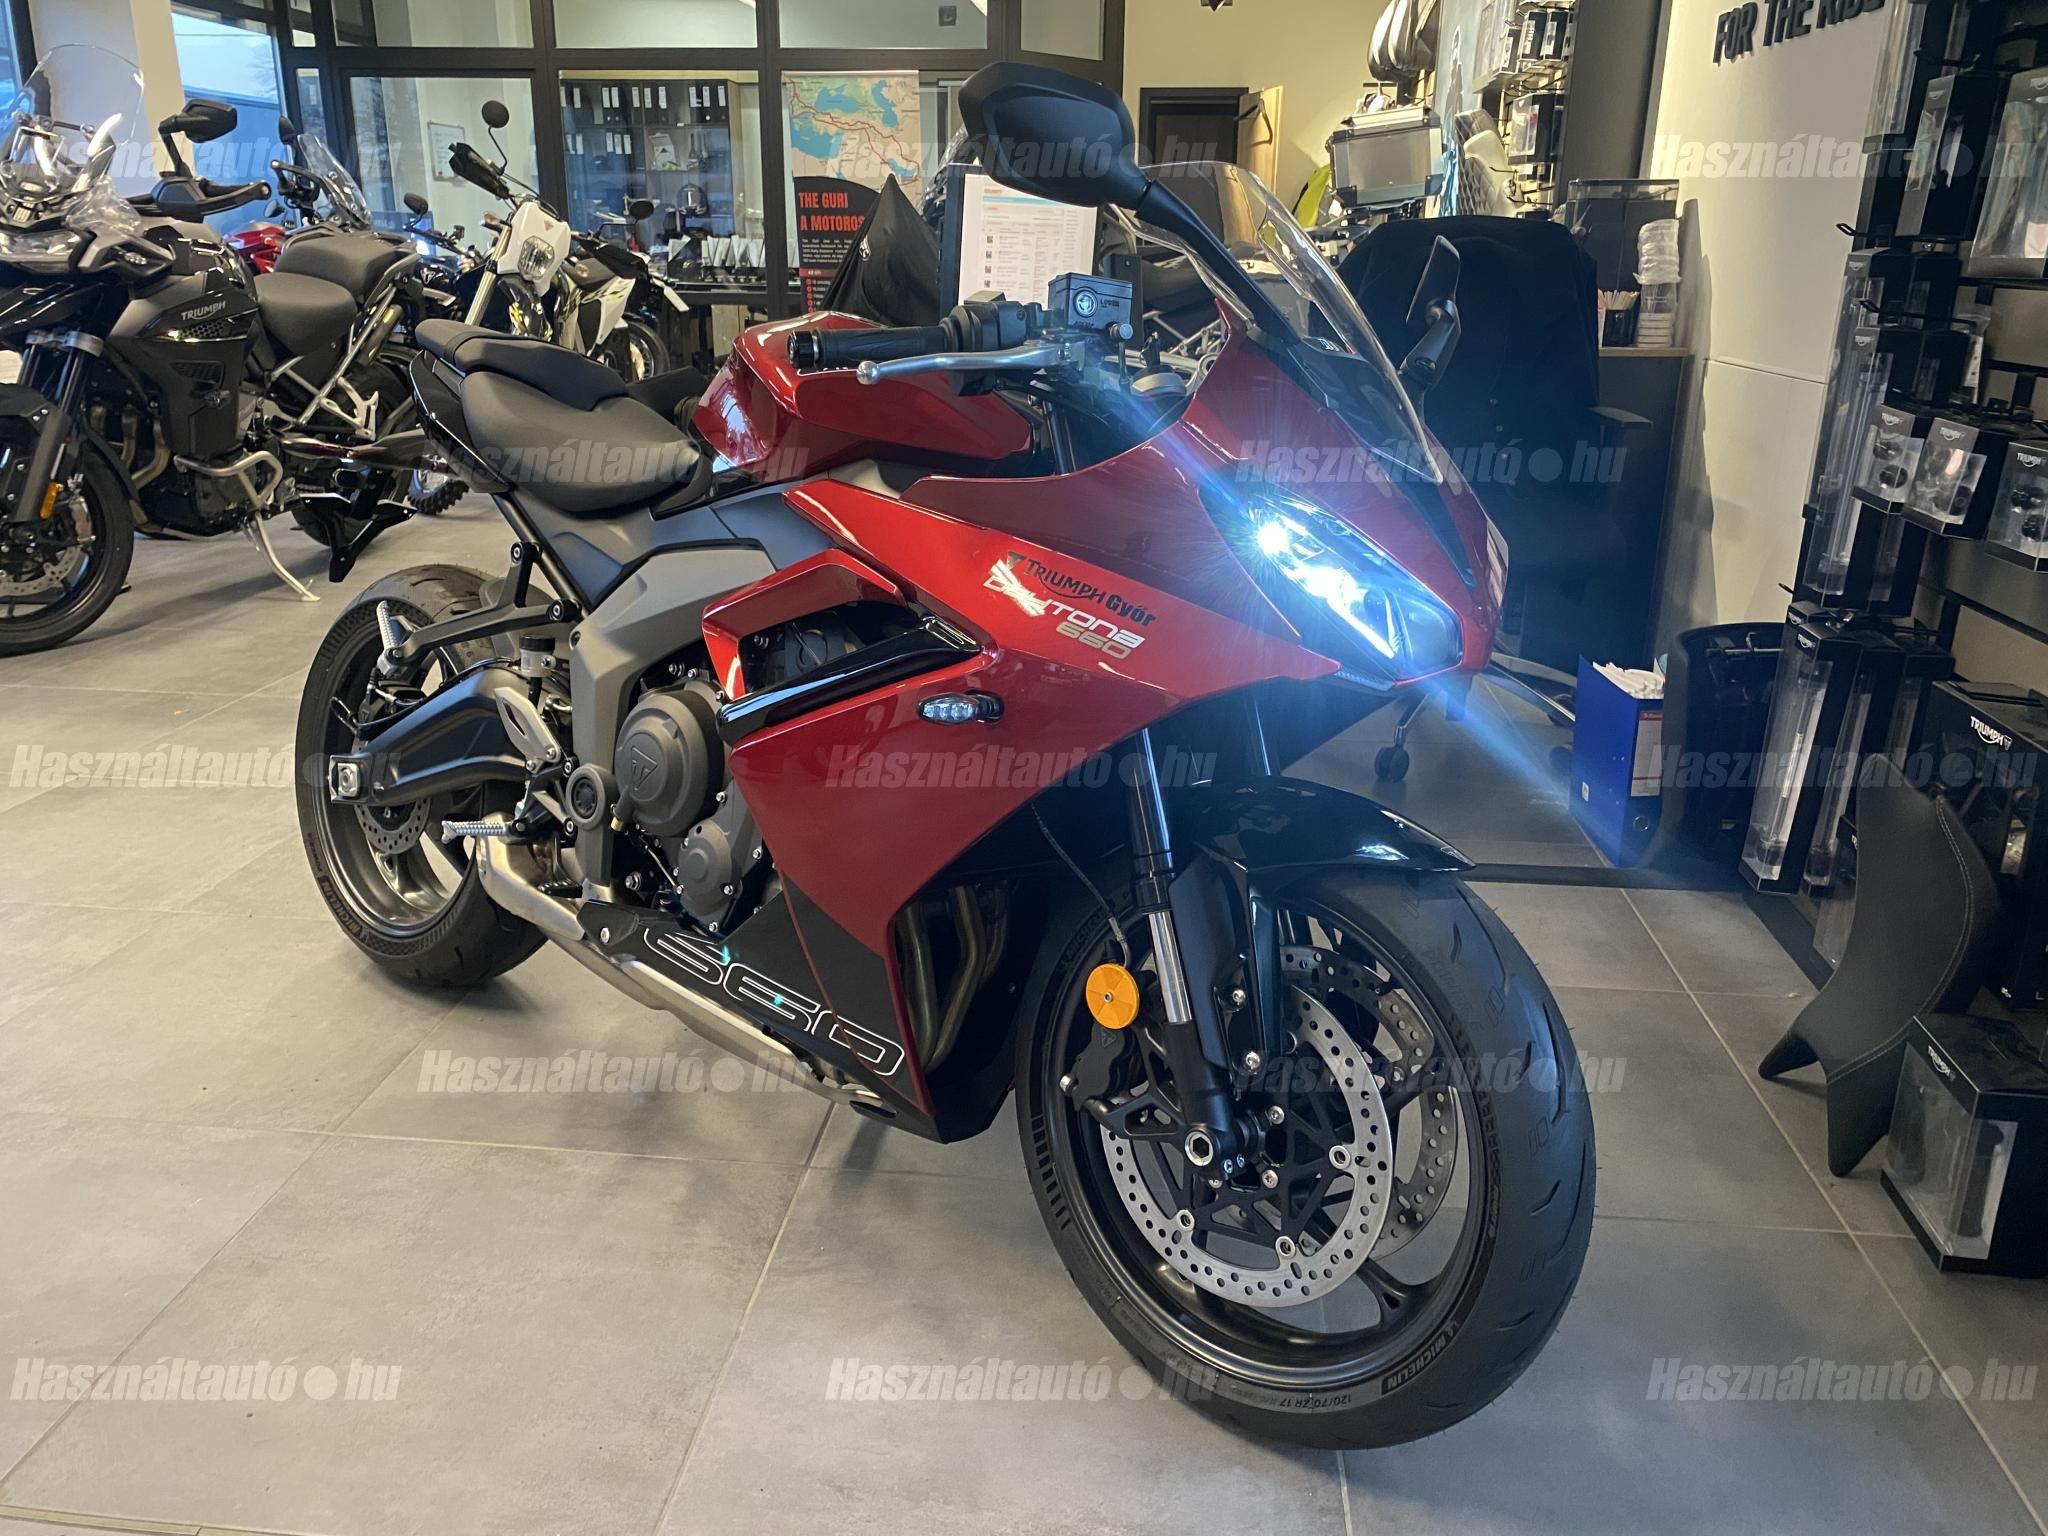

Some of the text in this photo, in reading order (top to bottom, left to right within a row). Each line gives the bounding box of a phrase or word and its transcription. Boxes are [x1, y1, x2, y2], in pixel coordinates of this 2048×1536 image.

[1713, 2, 1758, 64] FOR
[1763, 0, 1813, 47] THE
[798, 192, 848, 209] THE GURI
[800, 215, 808, 231] A
[180, 300, 226, 320] TRIUMPH
[1024, 559, 1106, 604] TRIUMPH
[1056, 621, 1132, 660] 660
[1970, 715, 2004, 746] TRIUMPH
[1387, 1333, 1447, 1390] MICHELIN
